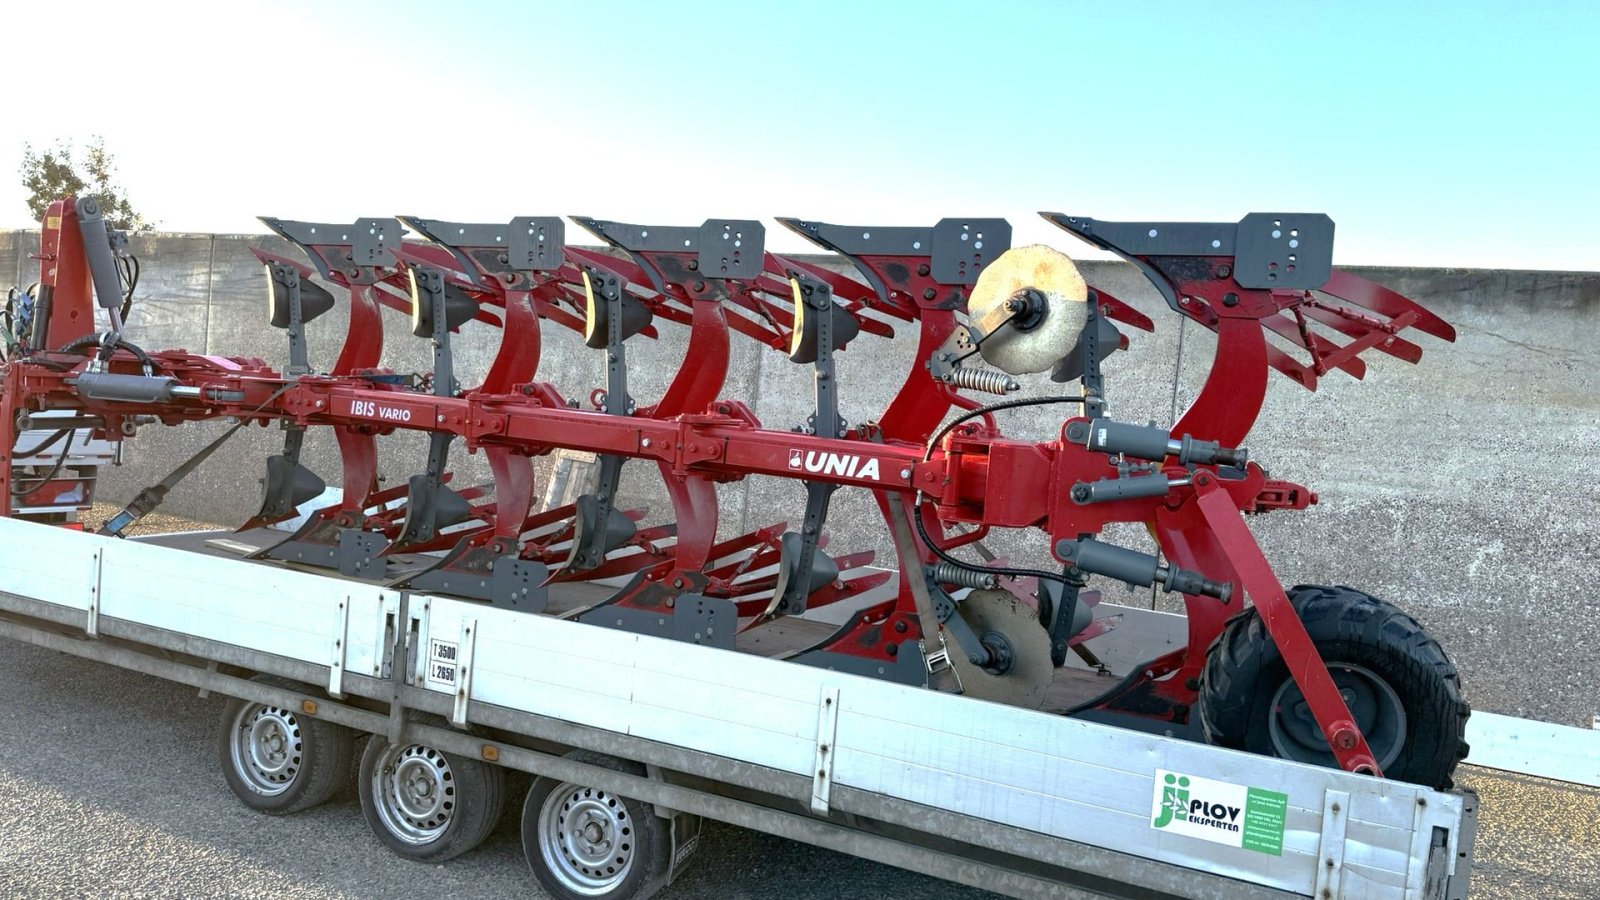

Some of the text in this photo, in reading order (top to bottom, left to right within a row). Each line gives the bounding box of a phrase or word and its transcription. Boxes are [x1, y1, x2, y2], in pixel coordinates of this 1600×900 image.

[351, 400, 411, 421] IBIS VARIO
[805, 451, 880, 481] UNIA
[438, 644, 456, 660] 3500
[437, 665, 455, 681] 2650
[1190, 799, 1241, 822] PLOV
[1188, 815, 1239, 832] EKSPERTEN
